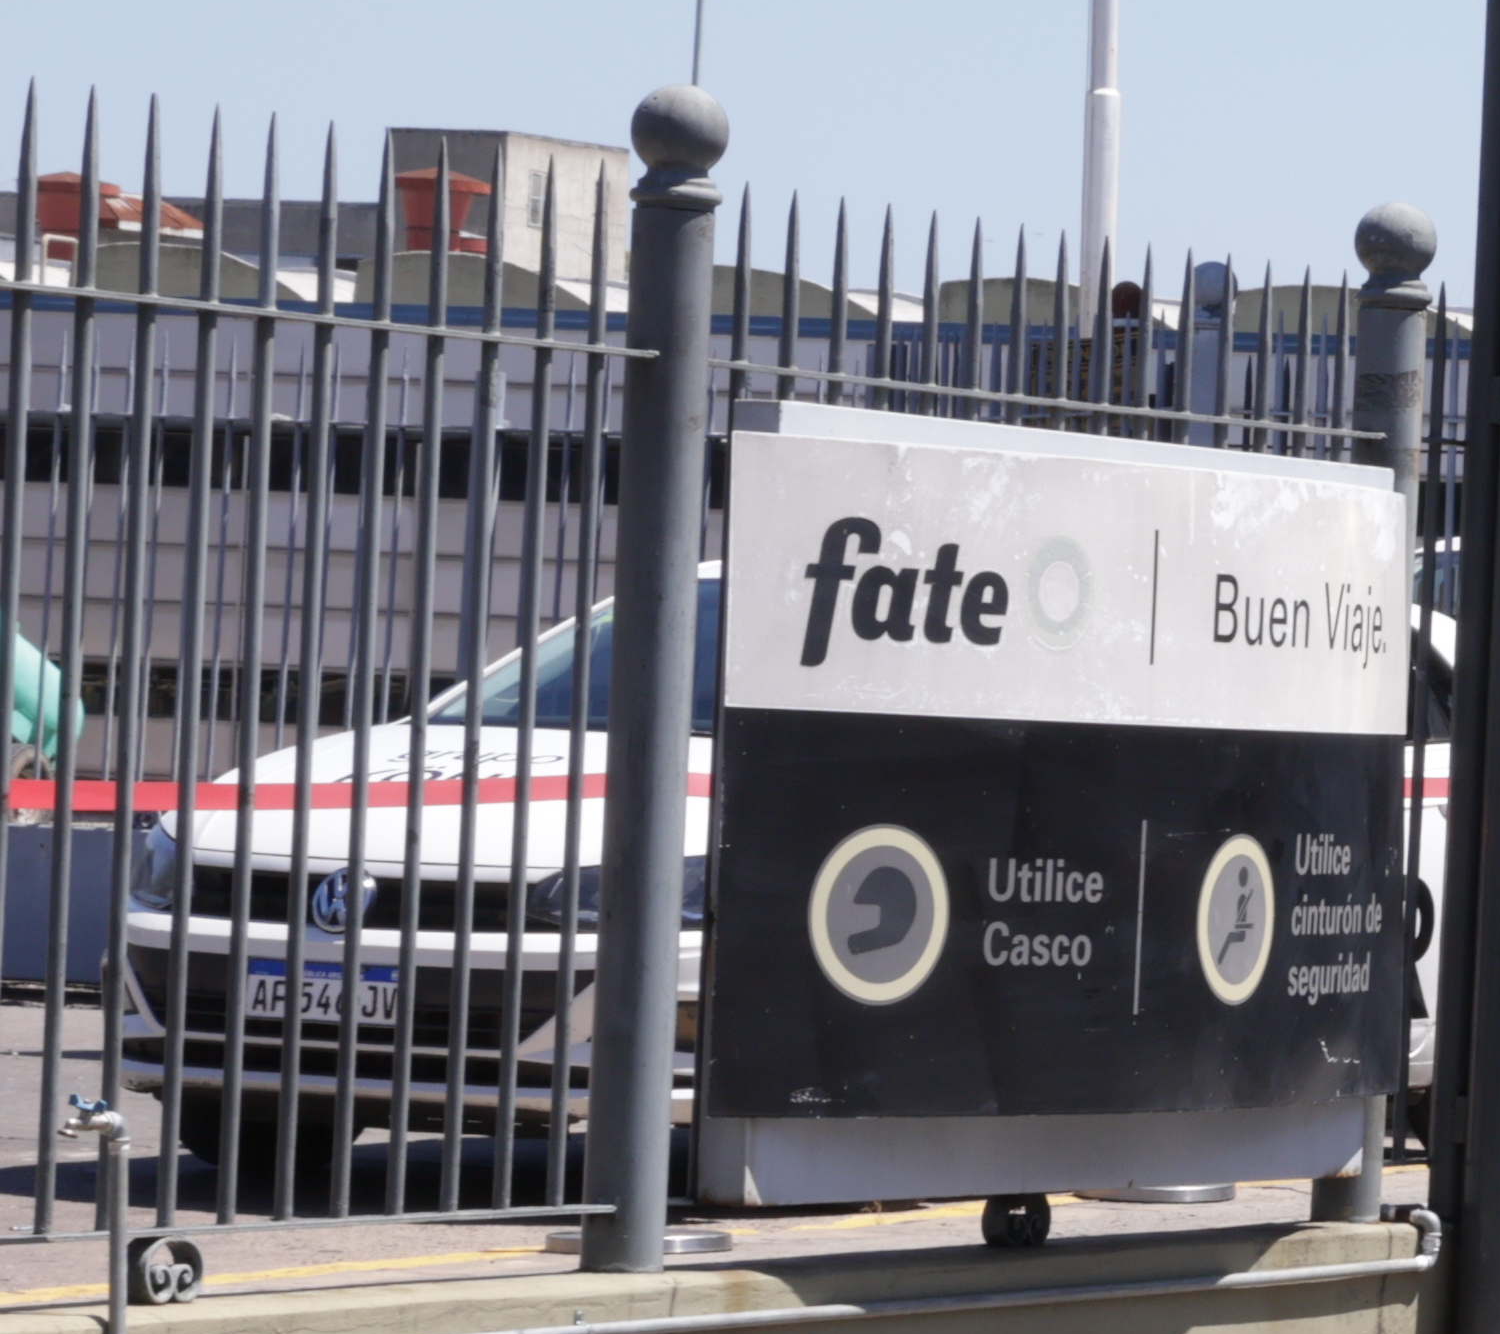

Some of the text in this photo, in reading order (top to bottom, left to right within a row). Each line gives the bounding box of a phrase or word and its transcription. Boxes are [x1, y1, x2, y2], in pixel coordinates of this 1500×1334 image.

[800, 515, 1010, 667] fate
[1212, 573, 1388, 668] Buen Viaje.
[1295, 833, 1352, 877] Utilice
[988, 857, 1105, 905] Utilice
[1290, 894, 1383, 937] cinturón de
[982, 920, 1093, 969] Casco
[1287, 959, 1372, 1007] seguridad
